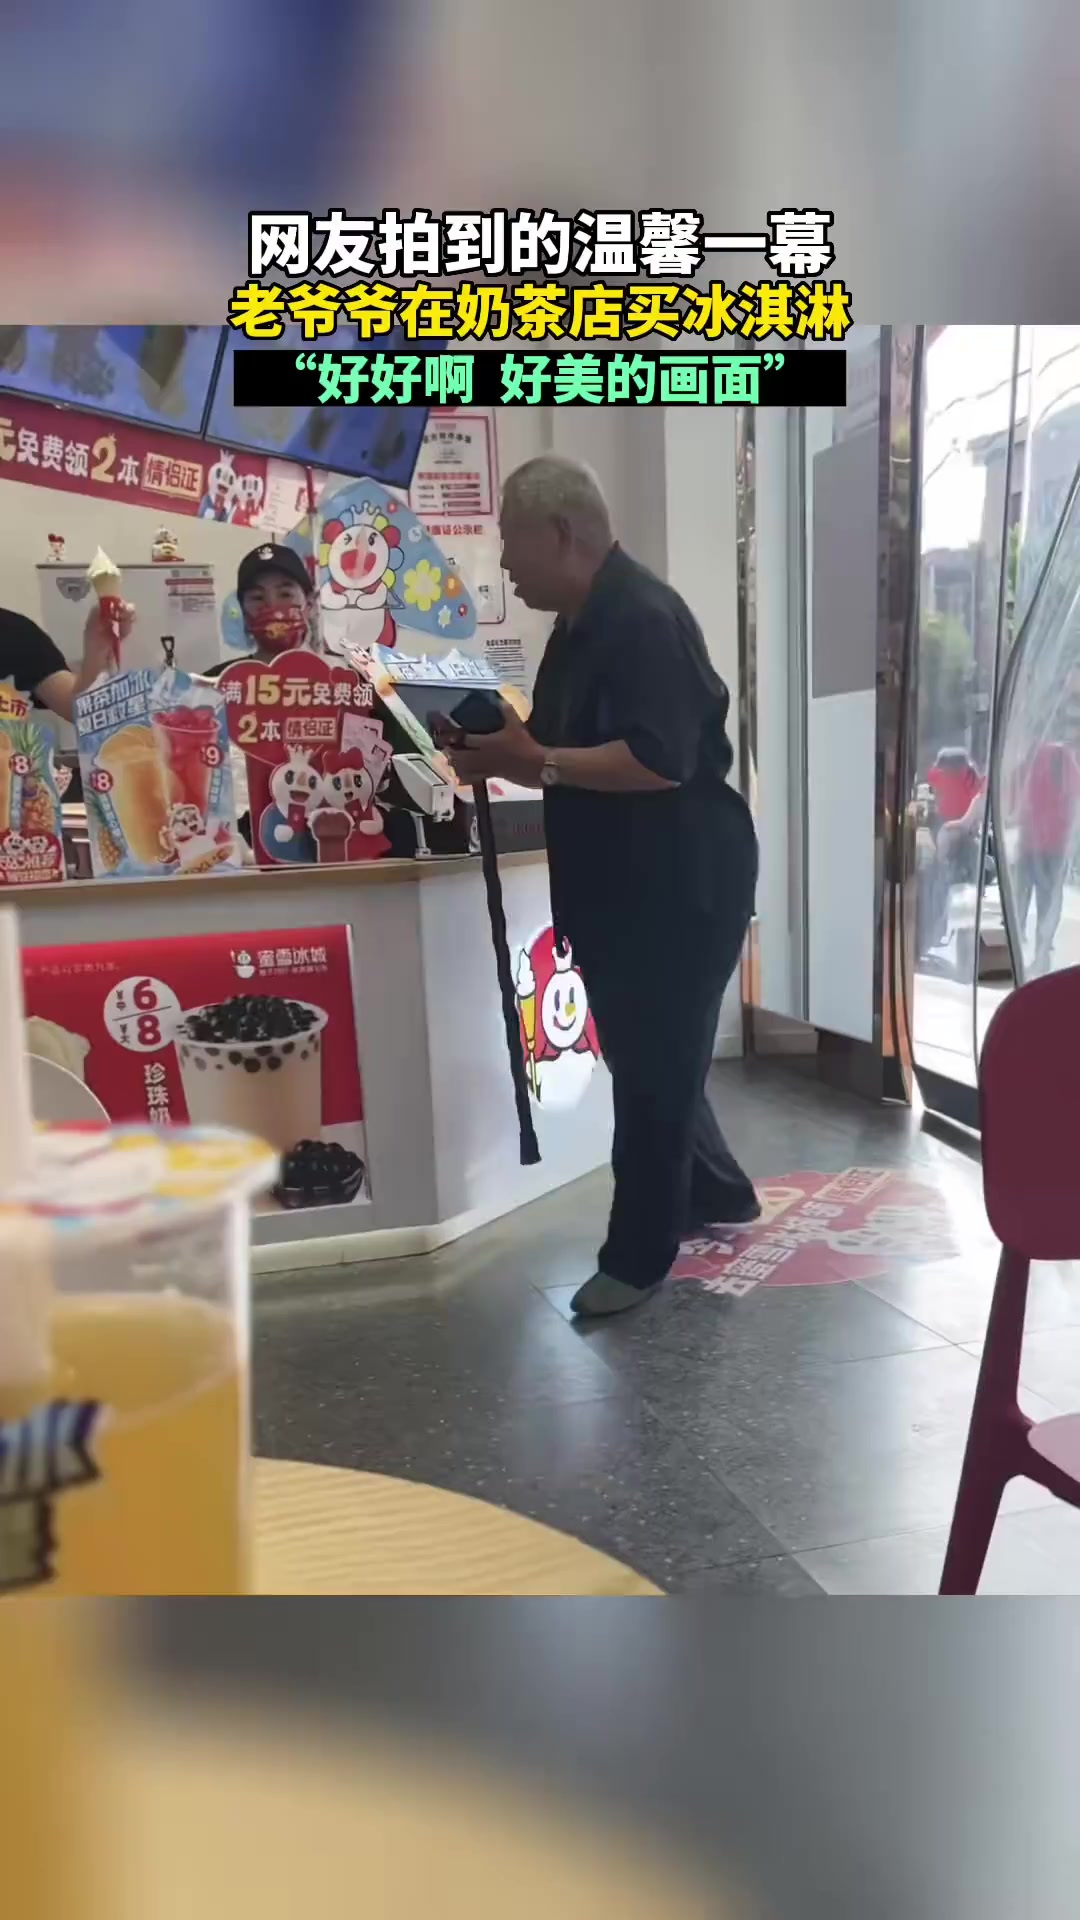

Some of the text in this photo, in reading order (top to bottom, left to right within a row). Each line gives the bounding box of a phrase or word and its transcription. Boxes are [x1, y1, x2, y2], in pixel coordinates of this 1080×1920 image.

[222, 674, 374, 707] 满15元免费领
[257, 946, 327, 968] 蜜雪冰城
[133, 979, 158, 1012] 6
[137, 1014, 162, 1047] 8
